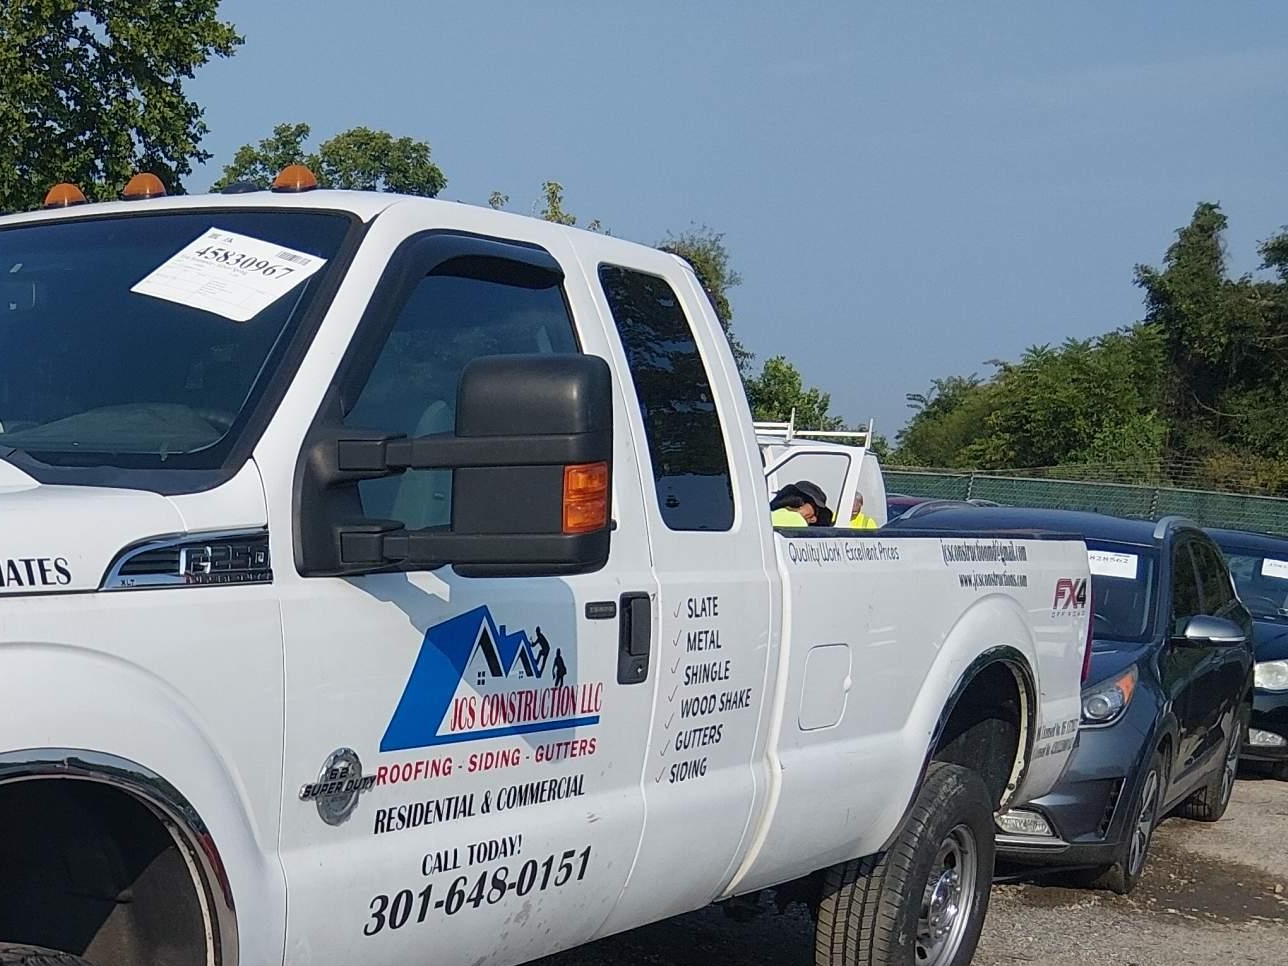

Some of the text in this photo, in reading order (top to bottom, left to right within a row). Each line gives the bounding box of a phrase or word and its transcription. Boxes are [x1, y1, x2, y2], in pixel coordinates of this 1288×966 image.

[196, 246, 297, 280] 45830967
[789, 542, 822, 567] Quality
[820, 542, 842, 562] Work
[878, 541, 900, 560] Prices
[120, 579, 135, 587] XLT
[1053, 577, 1087, 610] FX4
[687, 596, 719, 618] SLATE
[686, 629, 722, 652] METAL
[684, 660, 731, 686] SHINGLE
[450, 682, 604, 732] JCS CONSTRUCTION LLC
[680, 688, 752, 719] WOOD SHAKE
[675, 723, 724, 751] GUTTERS
[376, 757, 453, 786] ROOFING
[467, 749, 521, 772] SIDING
[535, 738, 597, 763] GUTTERS
[669, 757, 707, 784] SIDING
[302, 775, 377, 798] SUPER DUTY
[374, 774, 585, 835] RESIDENTIAL & COMMERCIAL
[421, 834, 523, 877] CALL TODAY!
[363, 845, 593, 937] 301-648-0151
